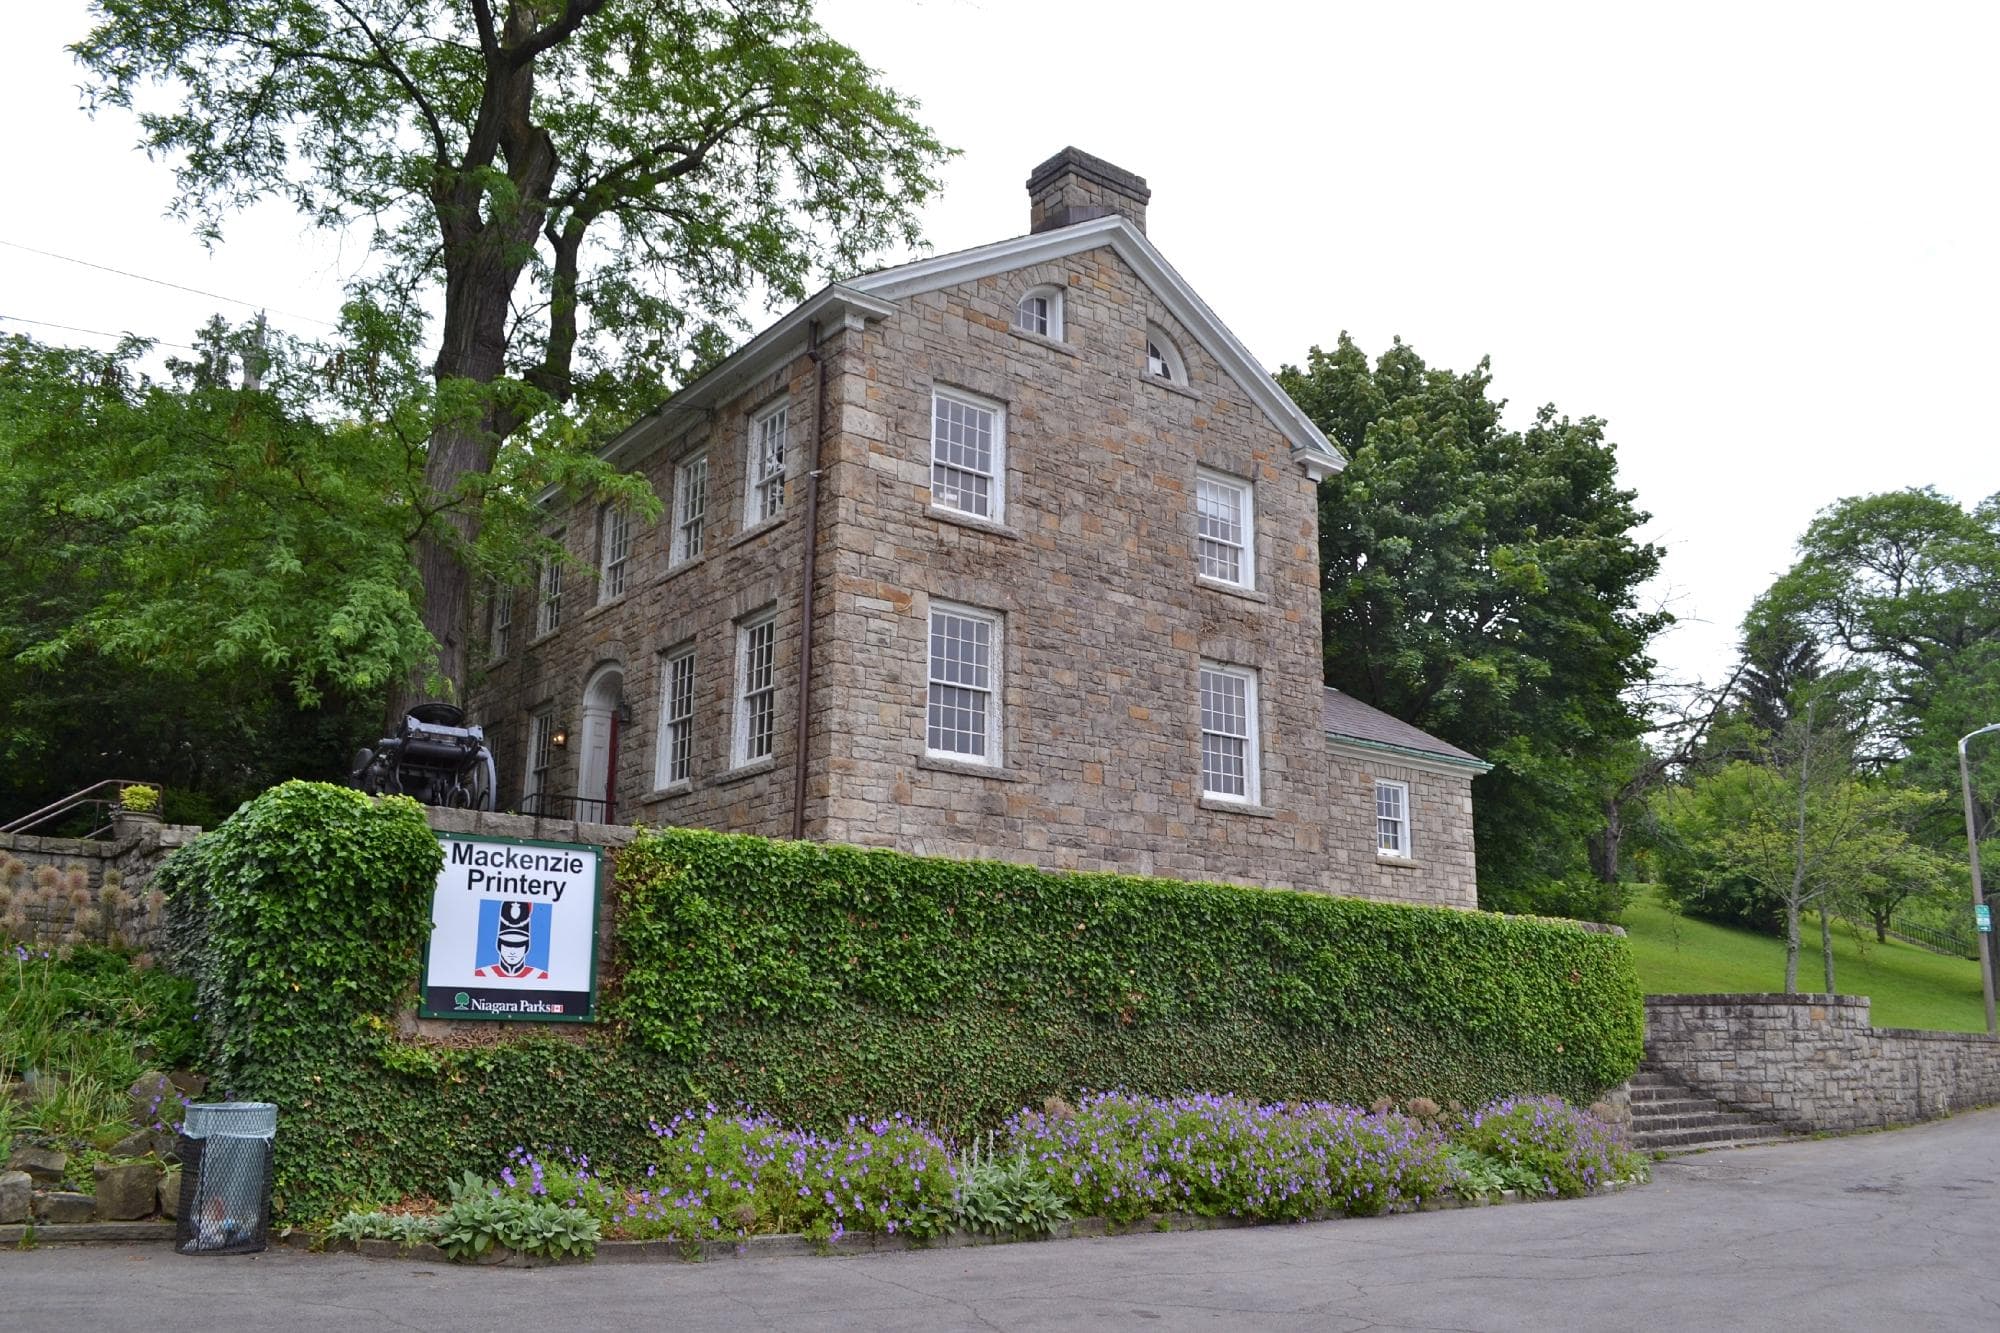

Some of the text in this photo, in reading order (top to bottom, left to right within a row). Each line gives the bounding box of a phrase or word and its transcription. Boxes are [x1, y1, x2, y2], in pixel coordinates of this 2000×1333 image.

[452, 842, 583, 874] Mackenzie
[467, 869, 567, 902] Printery
[471, 998, 551, 1015] Niagara Parks
